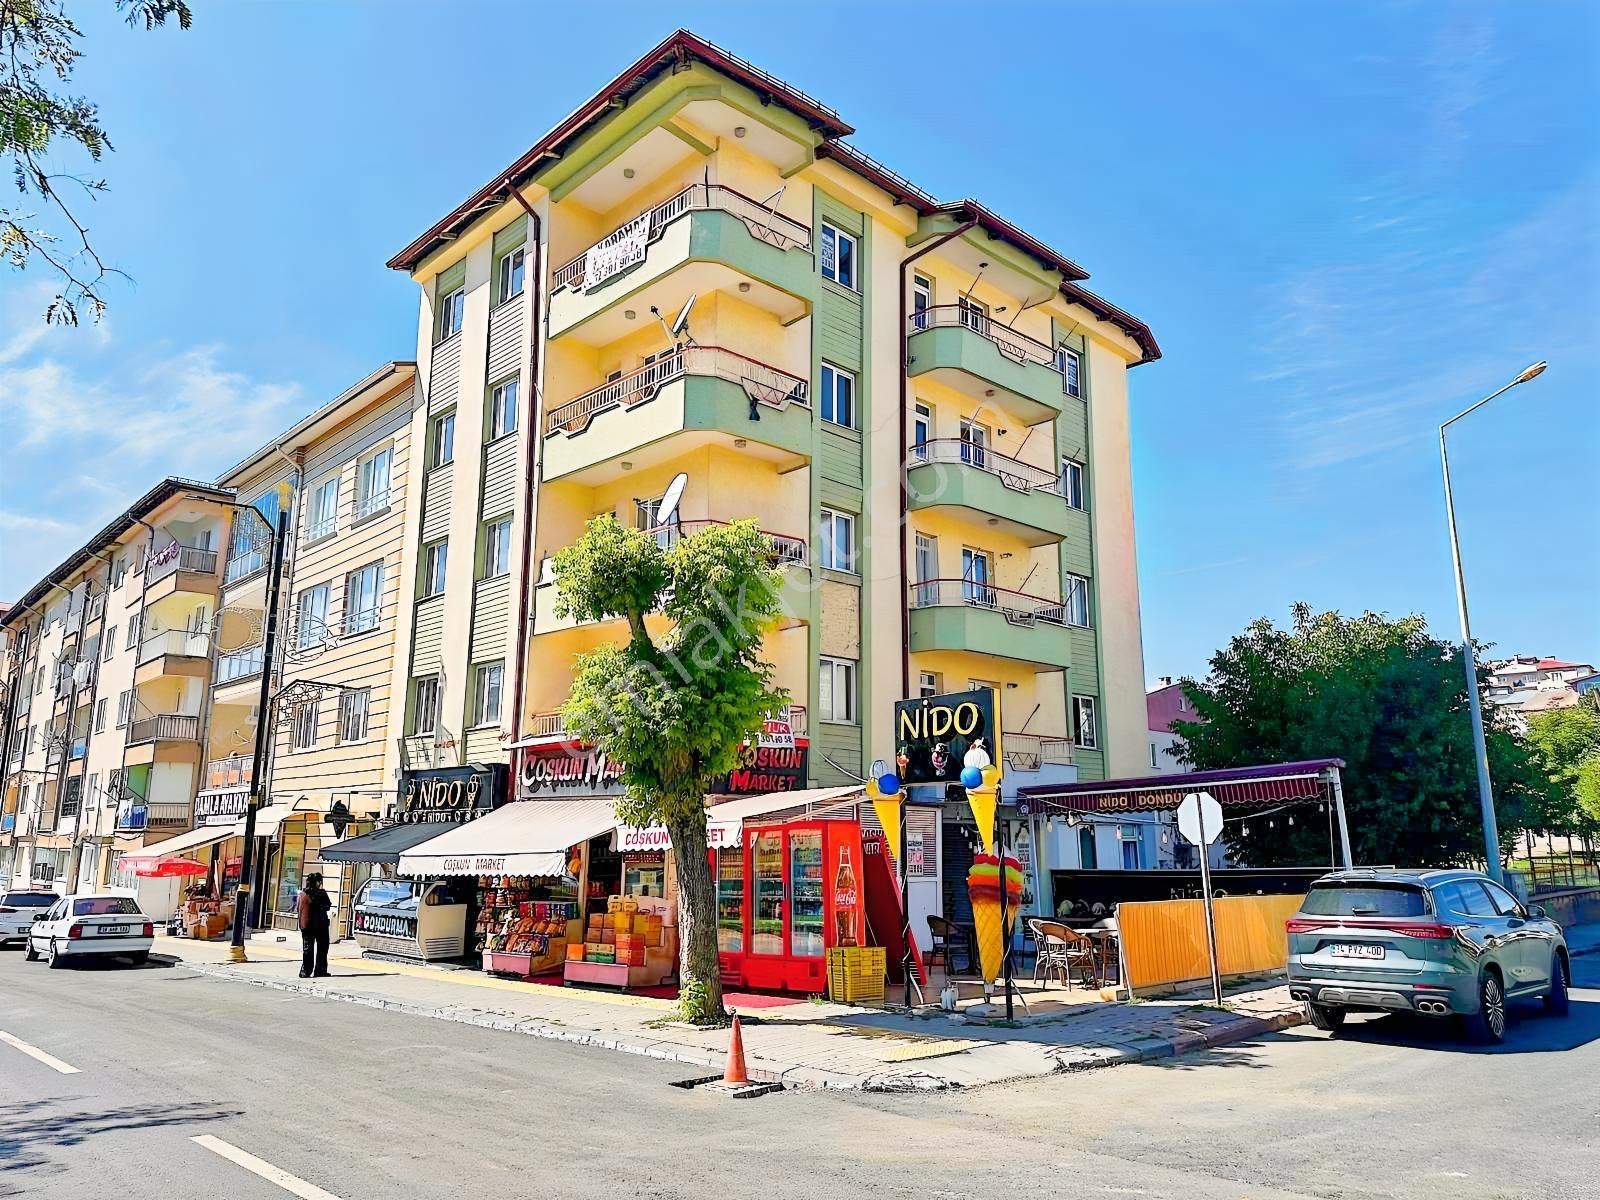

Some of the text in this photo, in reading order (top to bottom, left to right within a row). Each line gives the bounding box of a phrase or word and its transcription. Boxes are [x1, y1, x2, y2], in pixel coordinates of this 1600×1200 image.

[900, 699, 979, 741] NİDO
[737, 746, 803, 770] OŞKUN
[728, 769, 797, 791] MARKET
[418, 776, 463, 809] NİDO
[443, 858, 506, 872] COŞKUN MARKET
